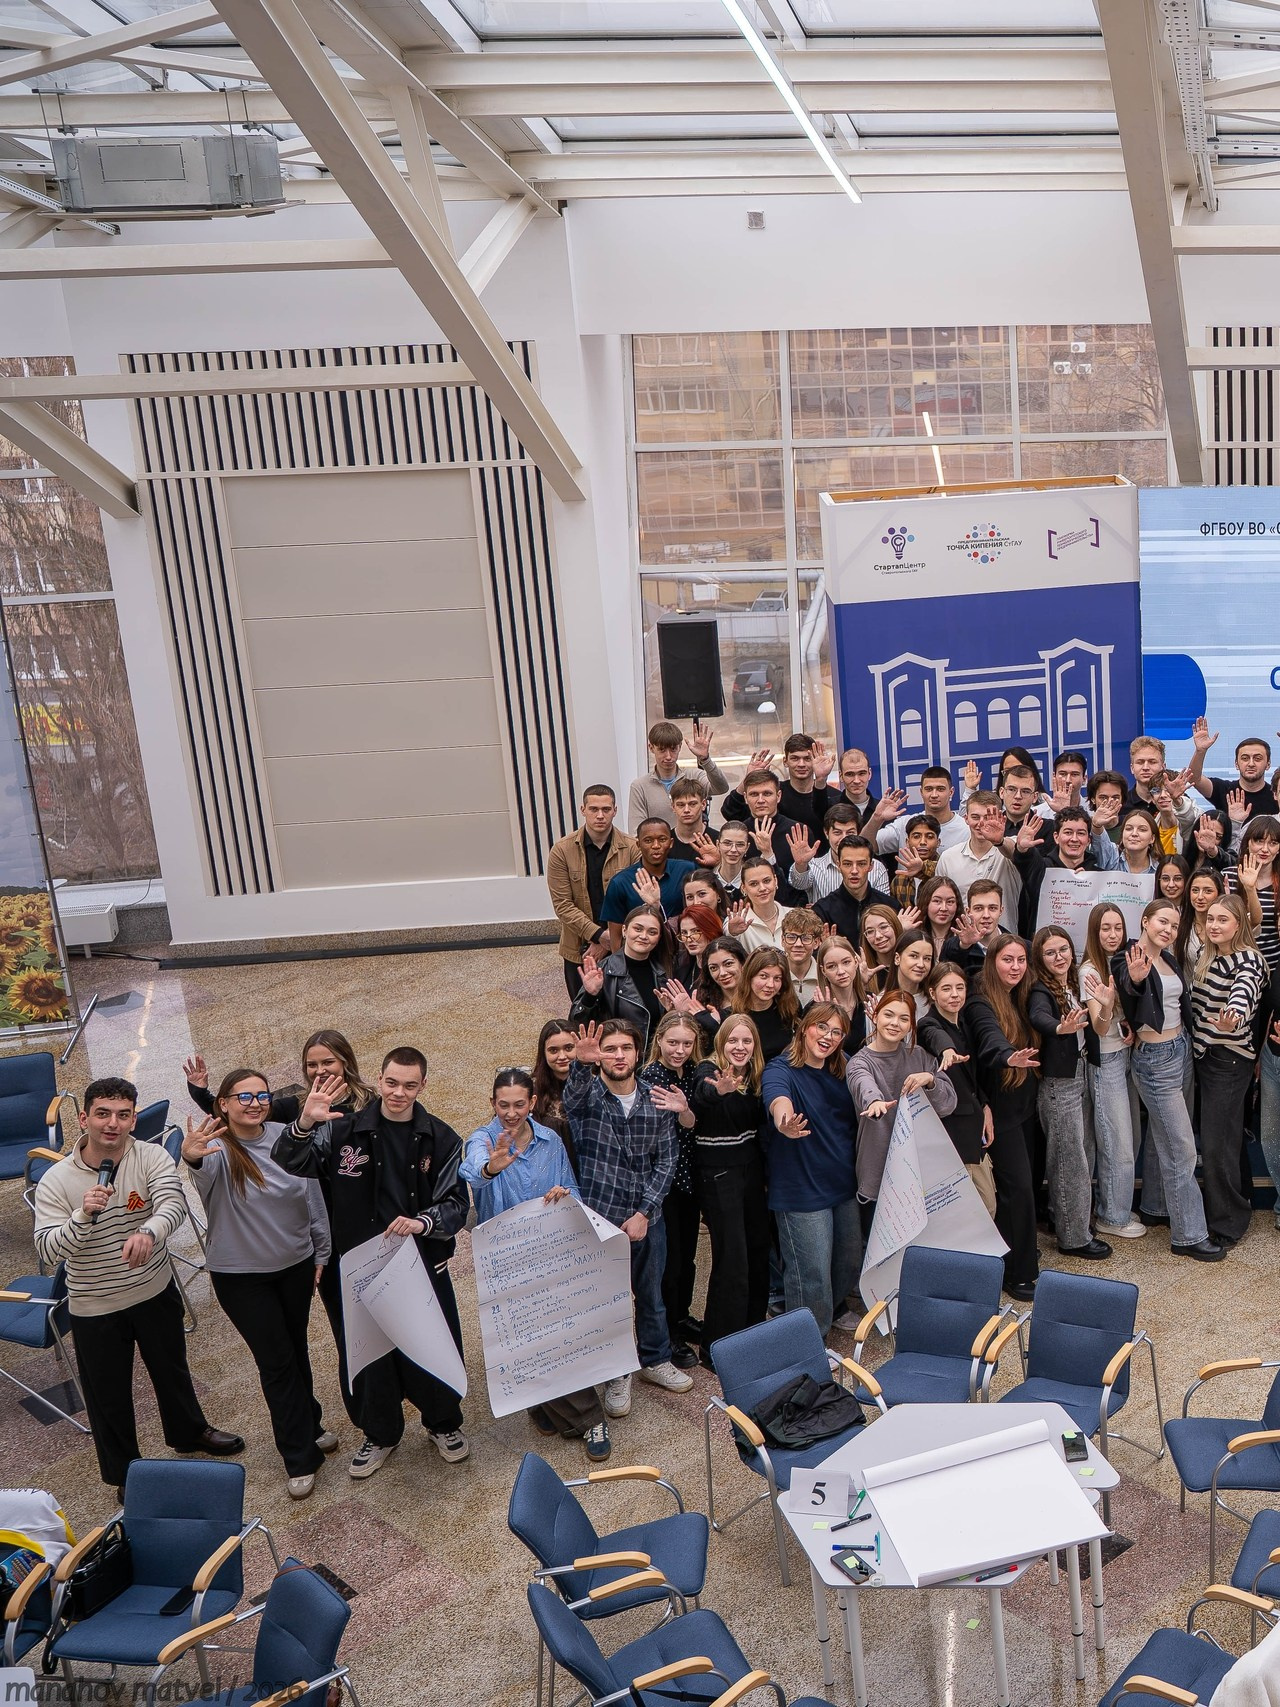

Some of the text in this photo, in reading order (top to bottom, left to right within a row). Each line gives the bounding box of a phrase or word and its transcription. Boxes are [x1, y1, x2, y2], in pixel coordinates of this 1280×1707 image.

[1200, 521, 1243, 536] ФГБОУ
[1248, 521, 1266, 535] ВО
[946, 543, 969, 551] ТОЧКА
[970, 541, 1003, 550] КИПЕНИЯ
[873, 562, 926, 572] СтартапЦентр
[810, 1481, 827, 1506] 5
